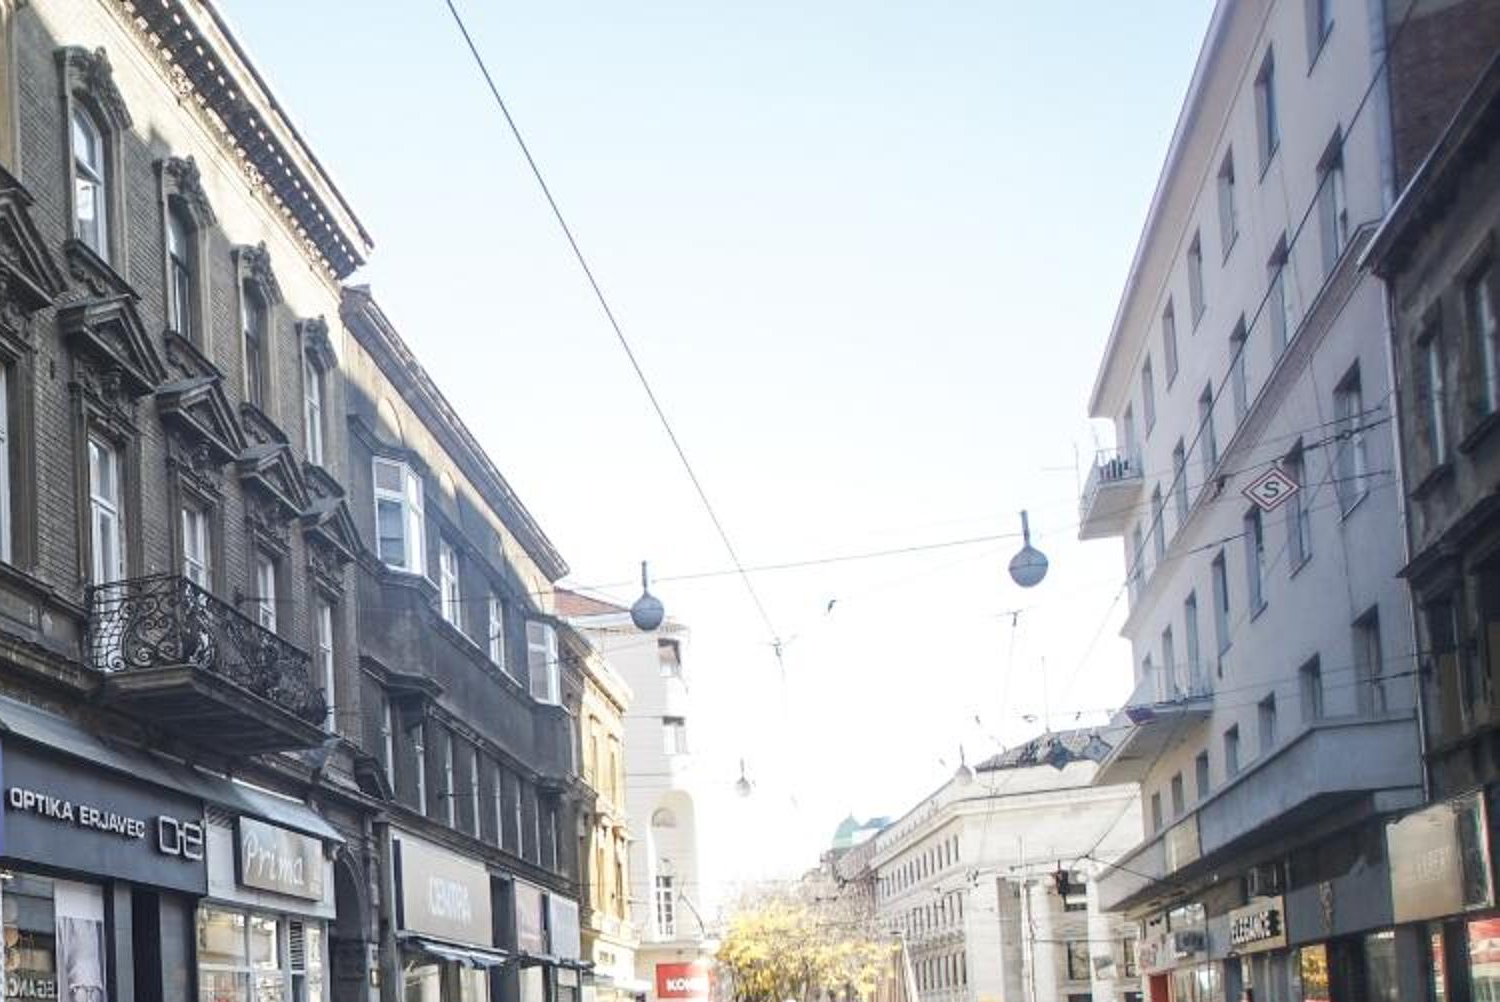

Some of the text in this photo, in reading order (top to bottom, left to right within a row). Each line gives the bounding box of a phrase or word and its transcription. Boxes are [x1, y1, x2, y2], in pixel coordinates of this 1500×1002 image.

[1263, 481, 1280, 498] S
[10, 787, 74, 821] OPTIKA
[79, 805, 146, 839] ERJAVEC
[1232, 909, 1280, 945] ELEGANCE
